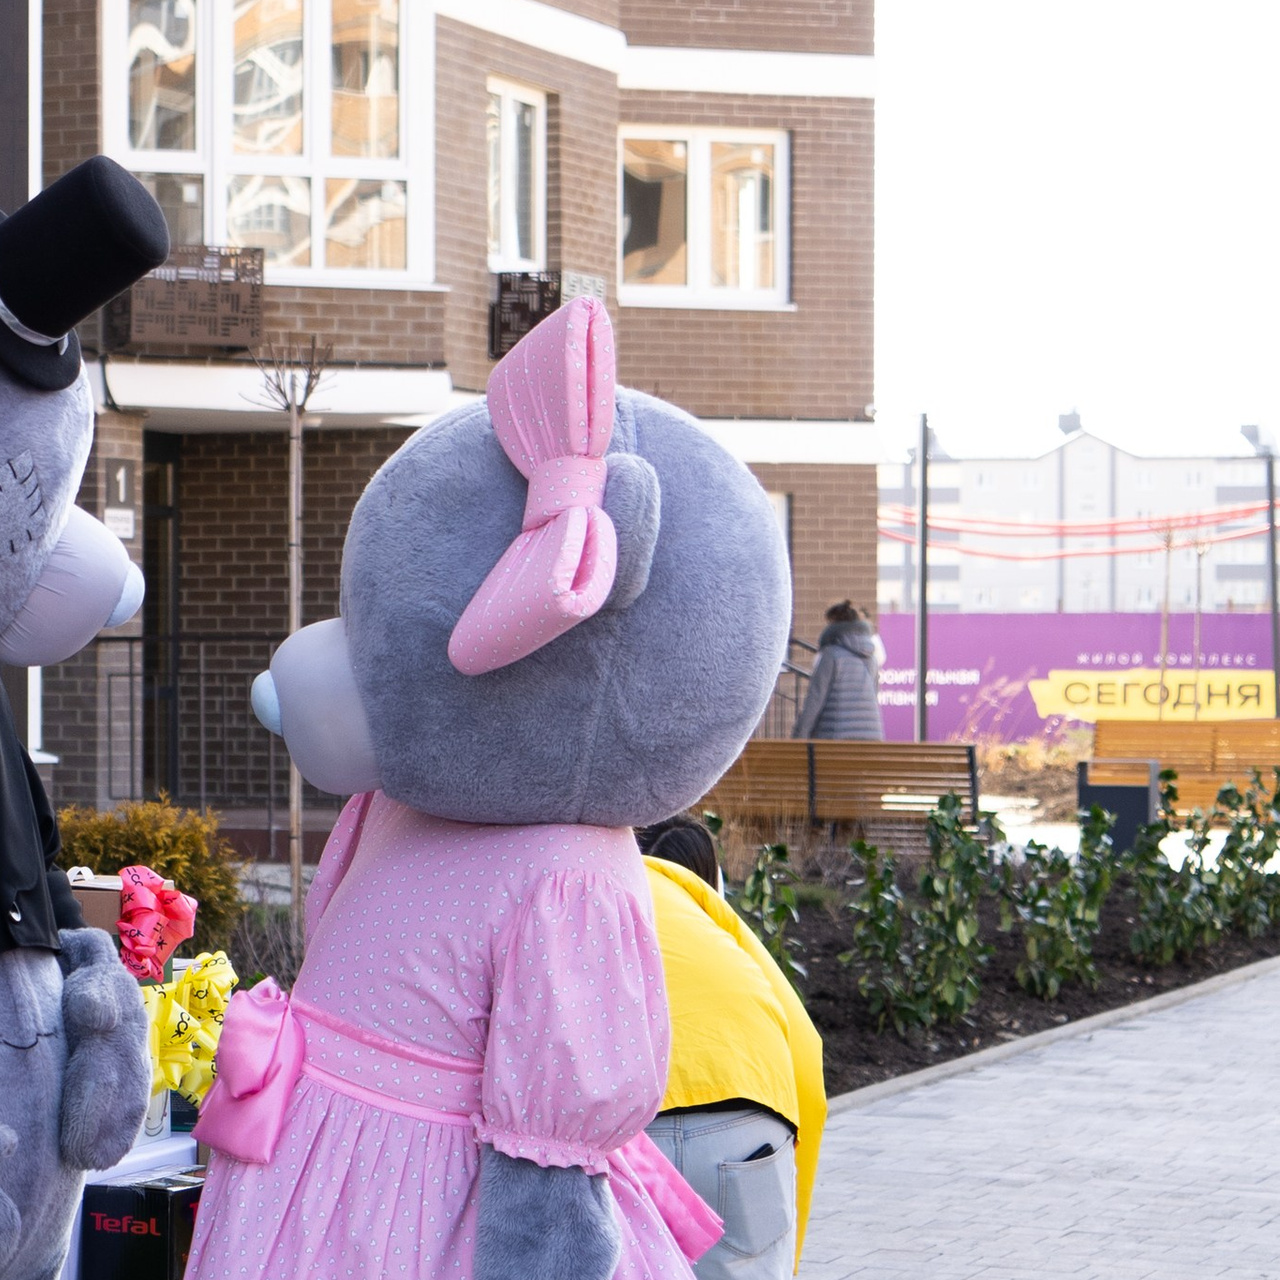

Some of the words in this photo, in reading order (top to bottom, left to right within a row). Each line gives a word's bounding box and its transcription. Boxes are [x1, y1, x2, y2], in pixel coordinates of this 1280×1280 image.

[115, 465, 126, 504] 1
[1076, 651, 1144, 666] ЖИЛОЙ
[1064, 681, 1262, 711] СЕГОДНЯ
[90, 1212, 161, 1236] Tefal
